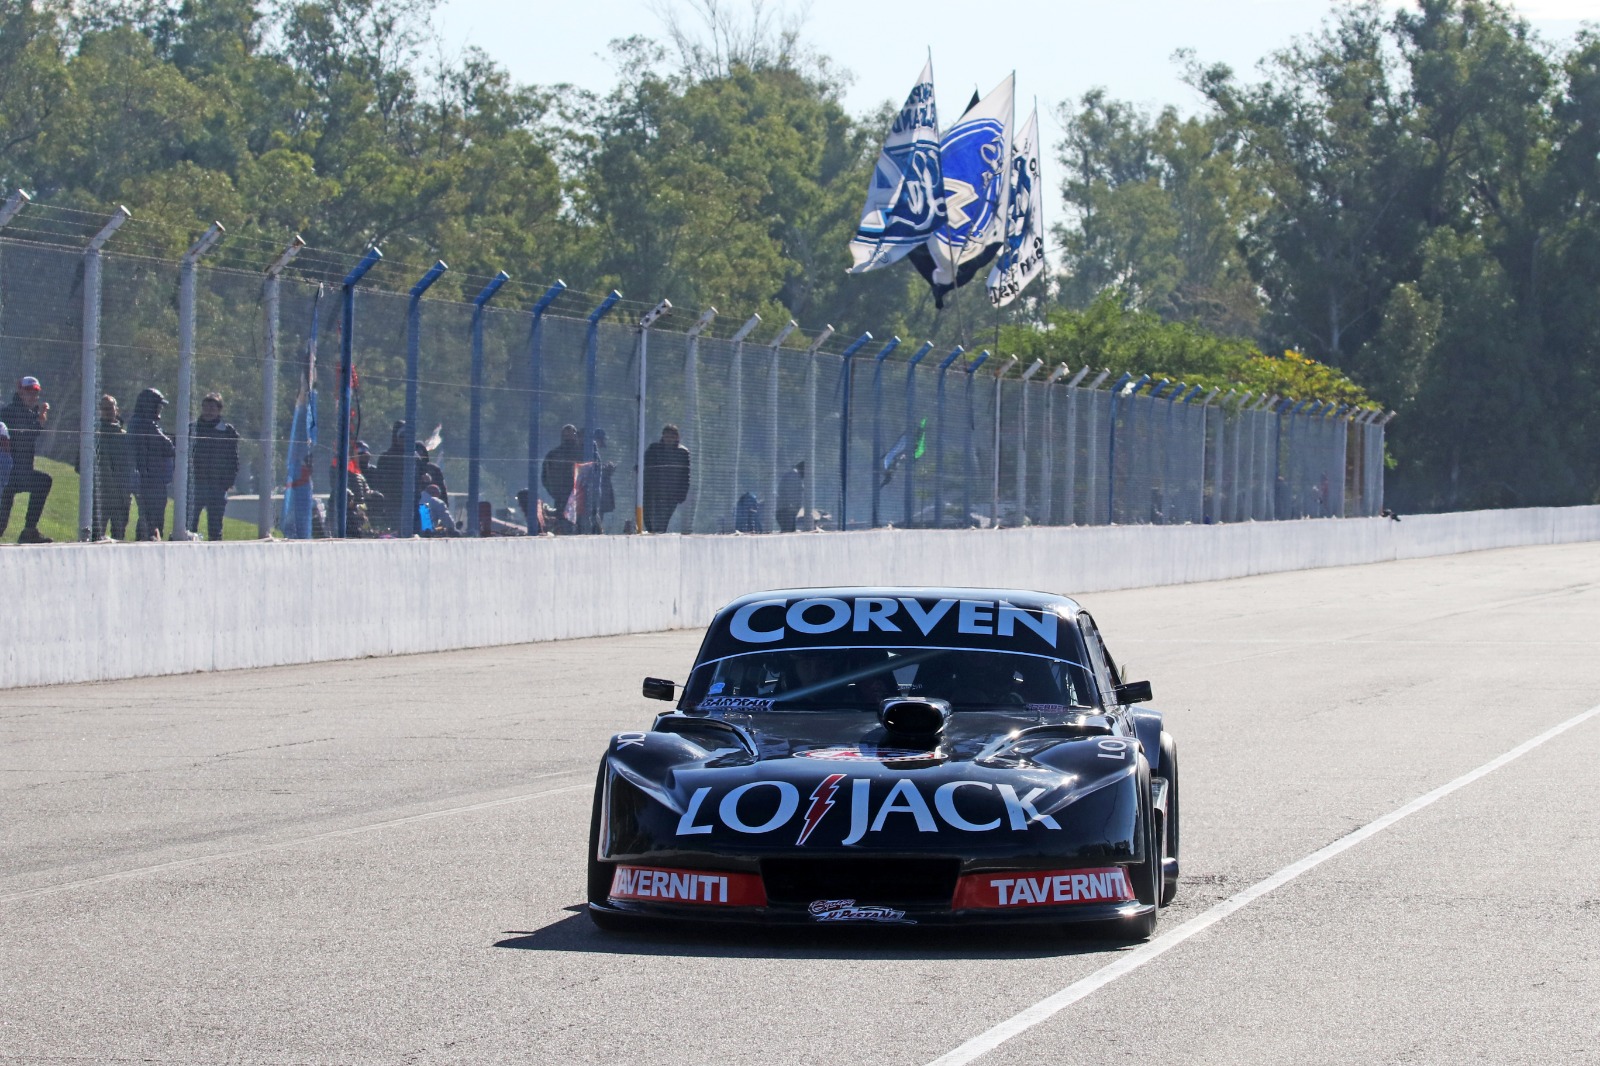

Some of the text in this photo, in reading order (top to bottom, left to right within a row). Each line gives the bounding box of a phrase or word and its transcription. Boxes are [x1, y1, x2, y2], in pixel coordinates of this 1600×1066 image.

[729, 597, 1057, 649] CORVEN
[615, 868, 728, 903] TAVERNITI
[990, 872, 1129, 906] TAVERNITI
